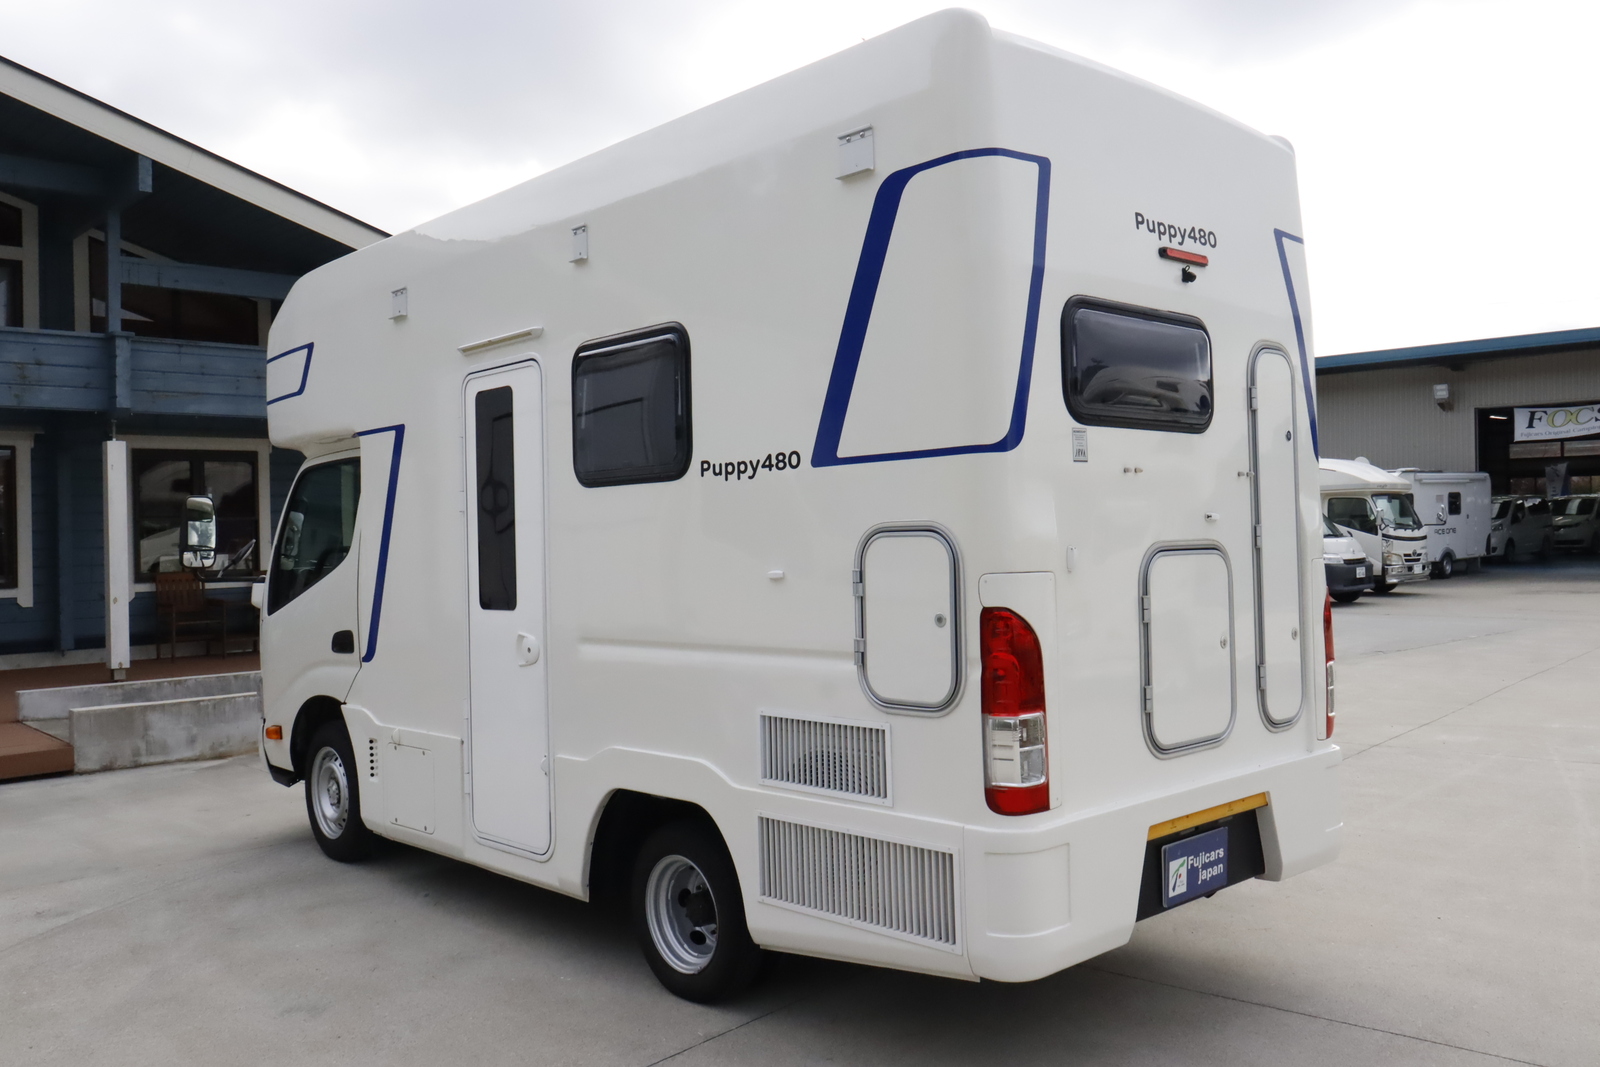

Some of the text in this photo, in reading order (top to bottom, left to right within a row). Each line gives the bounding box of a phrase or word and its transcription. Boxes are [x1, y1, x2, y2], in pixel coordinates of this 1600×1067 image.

[1134, 211, 1217, 249] Puppy480
[1545, 429, 1571, 437] Original
[700, 450, 801, 482] Puppy480
[1187, 847, 1225, 870] Fujicars
[1197, 863, 1224, 885] japan
